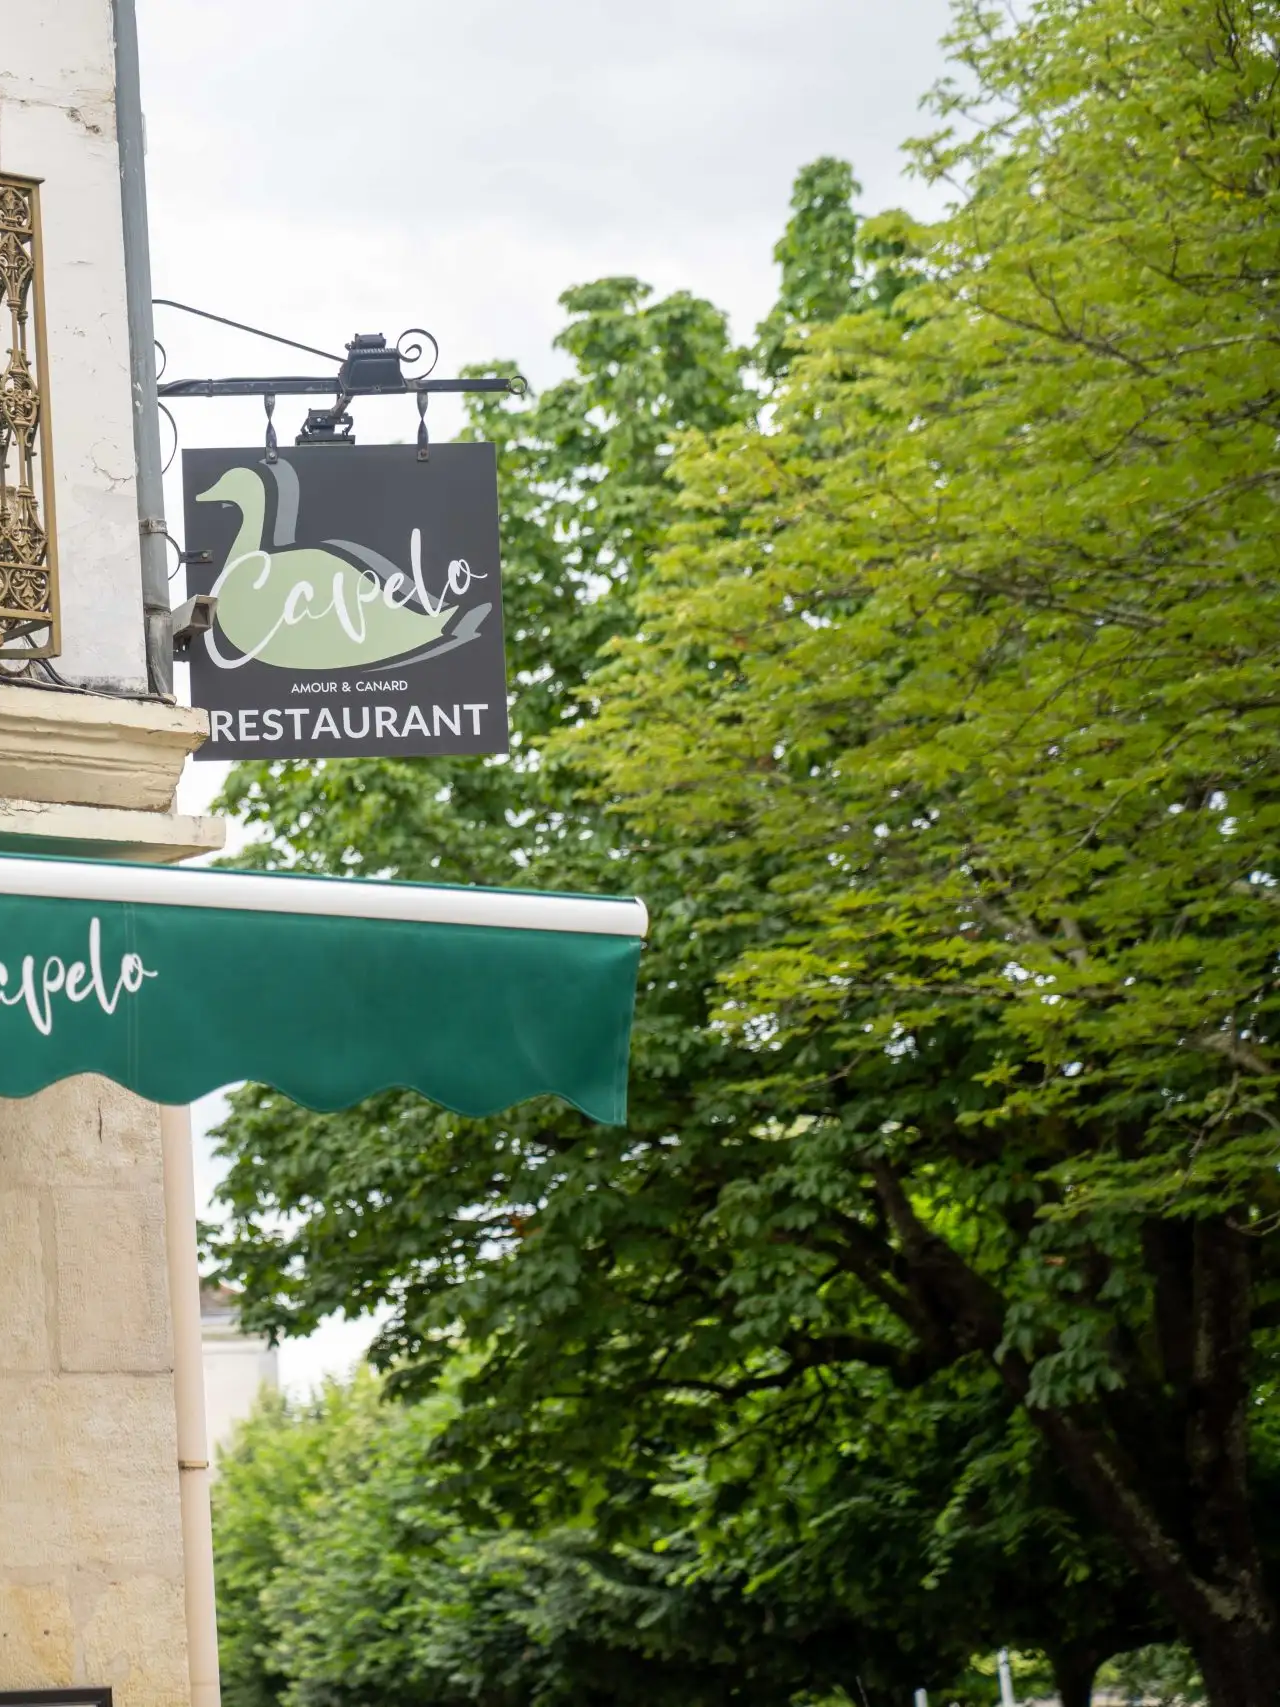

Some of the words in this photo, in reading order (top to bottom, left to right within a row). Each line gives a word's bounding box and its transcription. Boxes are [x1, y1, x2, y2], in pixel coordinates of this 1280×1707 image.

[204, 528, 487, 669] Capelo
[291, 682, 337, 693] AMOUR
[342, 682, 351, 692] &
[356, 680, 408, 692] CANARD
[210, 704, 489, 742] RESTAURANT
